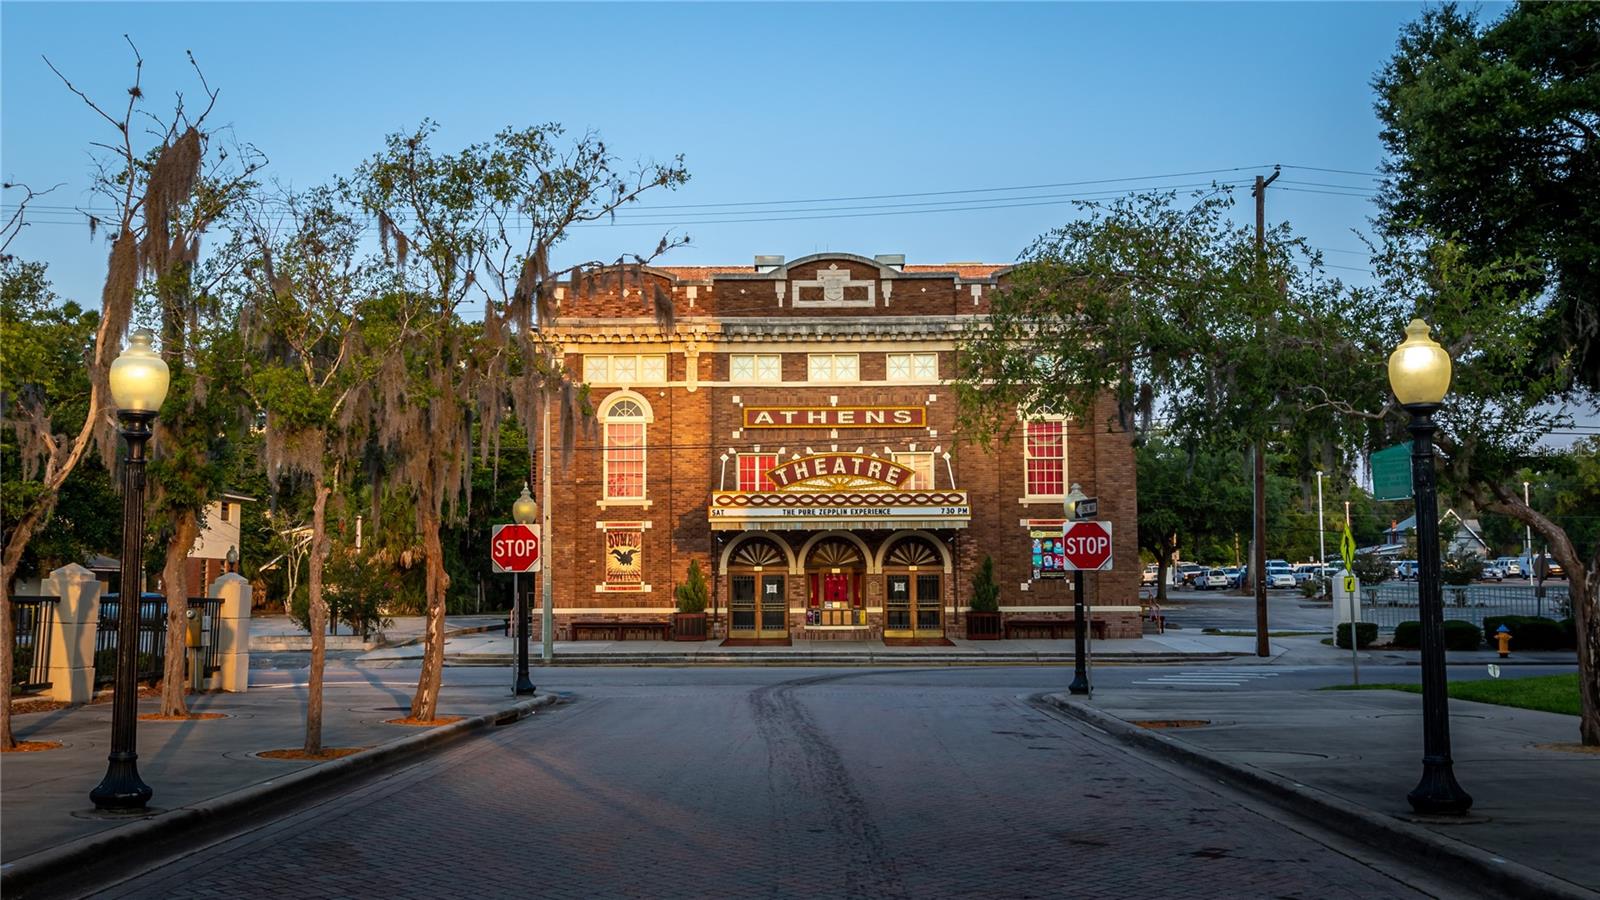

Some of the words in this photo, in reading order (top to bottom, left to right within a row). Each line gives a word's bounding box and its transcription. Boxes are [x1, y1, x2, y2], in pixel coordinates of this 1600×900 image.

[754, 410, 912, 424] ATHENS
[775, 457, 902, 486] THEATRE
[495, 539, 536, 557] STOP
[1067, 537, 1107, 554] STOP
